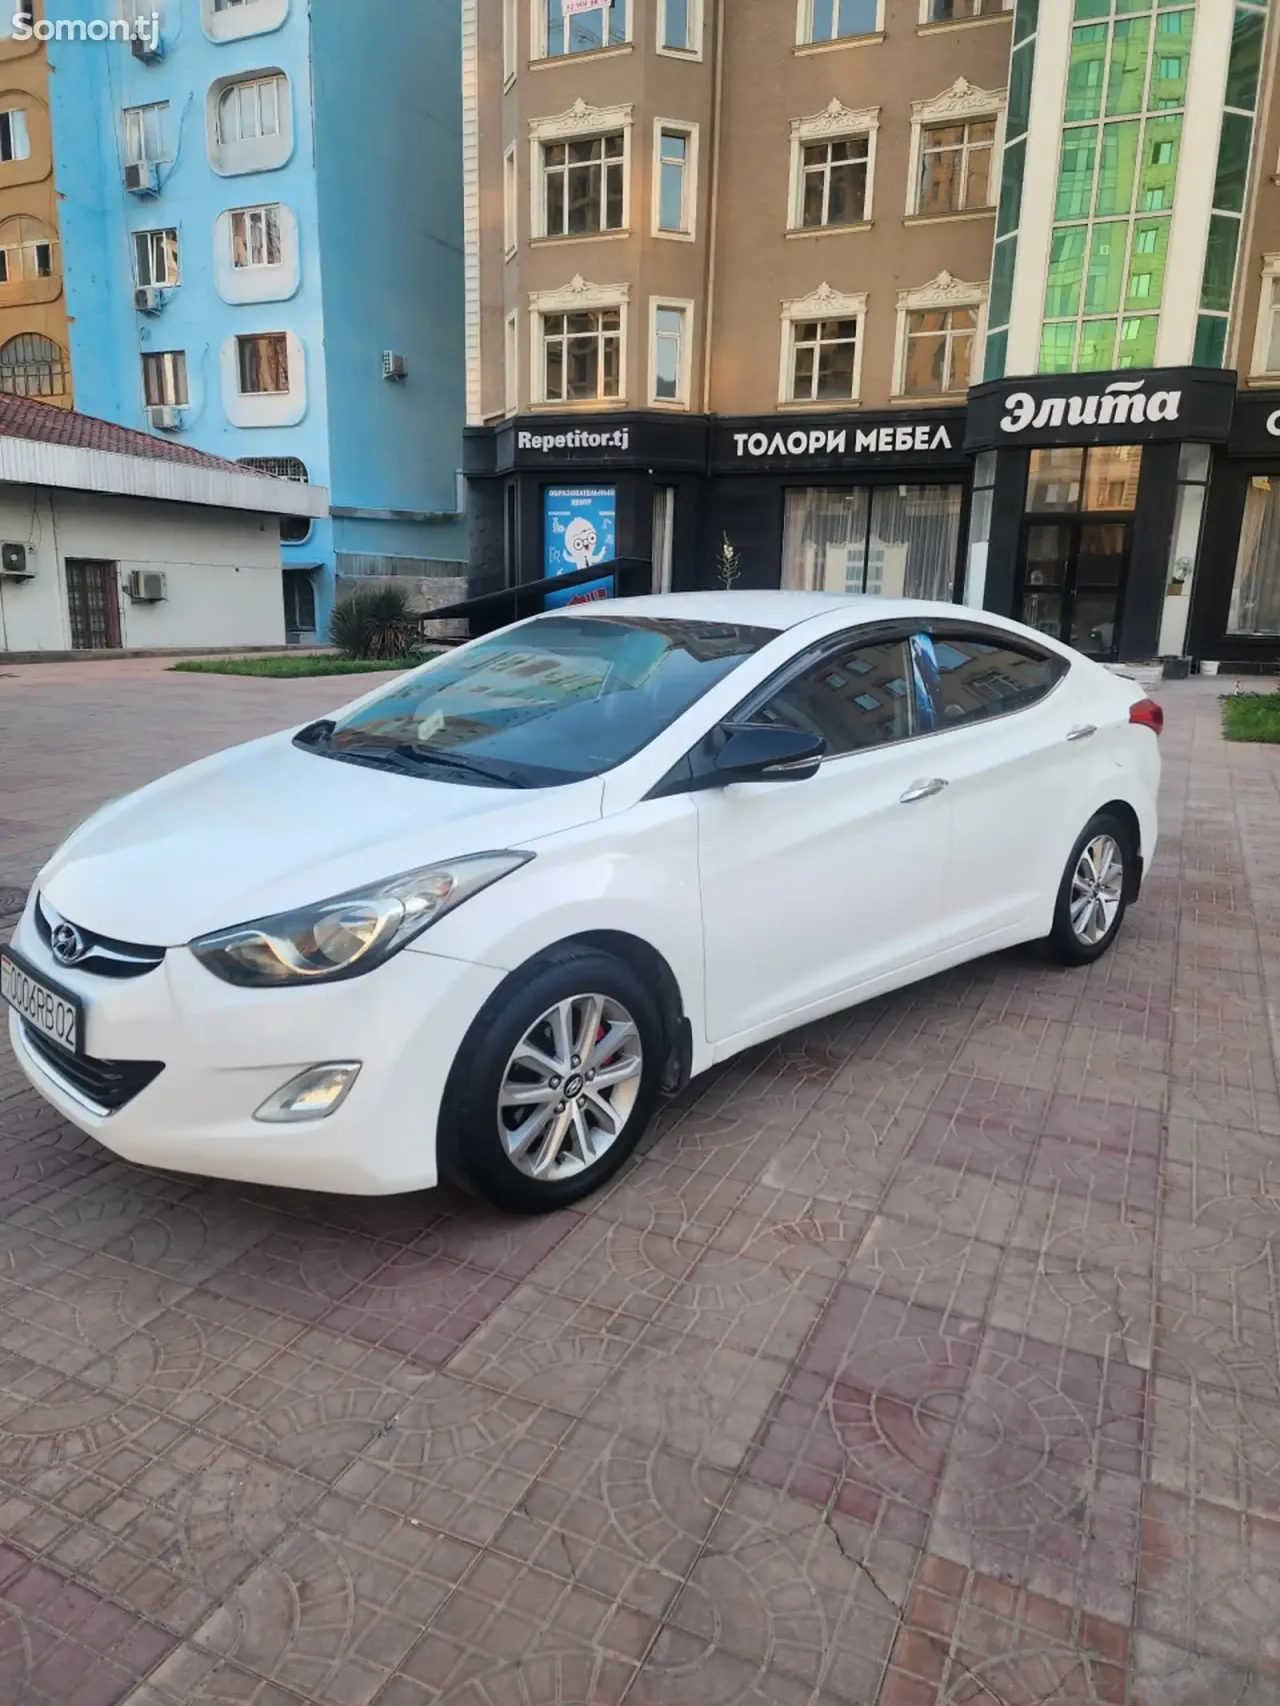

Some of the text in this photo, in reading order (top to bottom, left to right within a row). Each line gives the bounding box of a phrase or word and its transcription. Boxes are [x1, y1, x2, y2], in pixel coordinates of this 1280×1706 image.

[999, 379, 1182, 433] Элита
[518, 427, 629, 453] Repetitor.tj
[733, 424, 953, 457] ТОЛОРИ МЕБЕЛ
